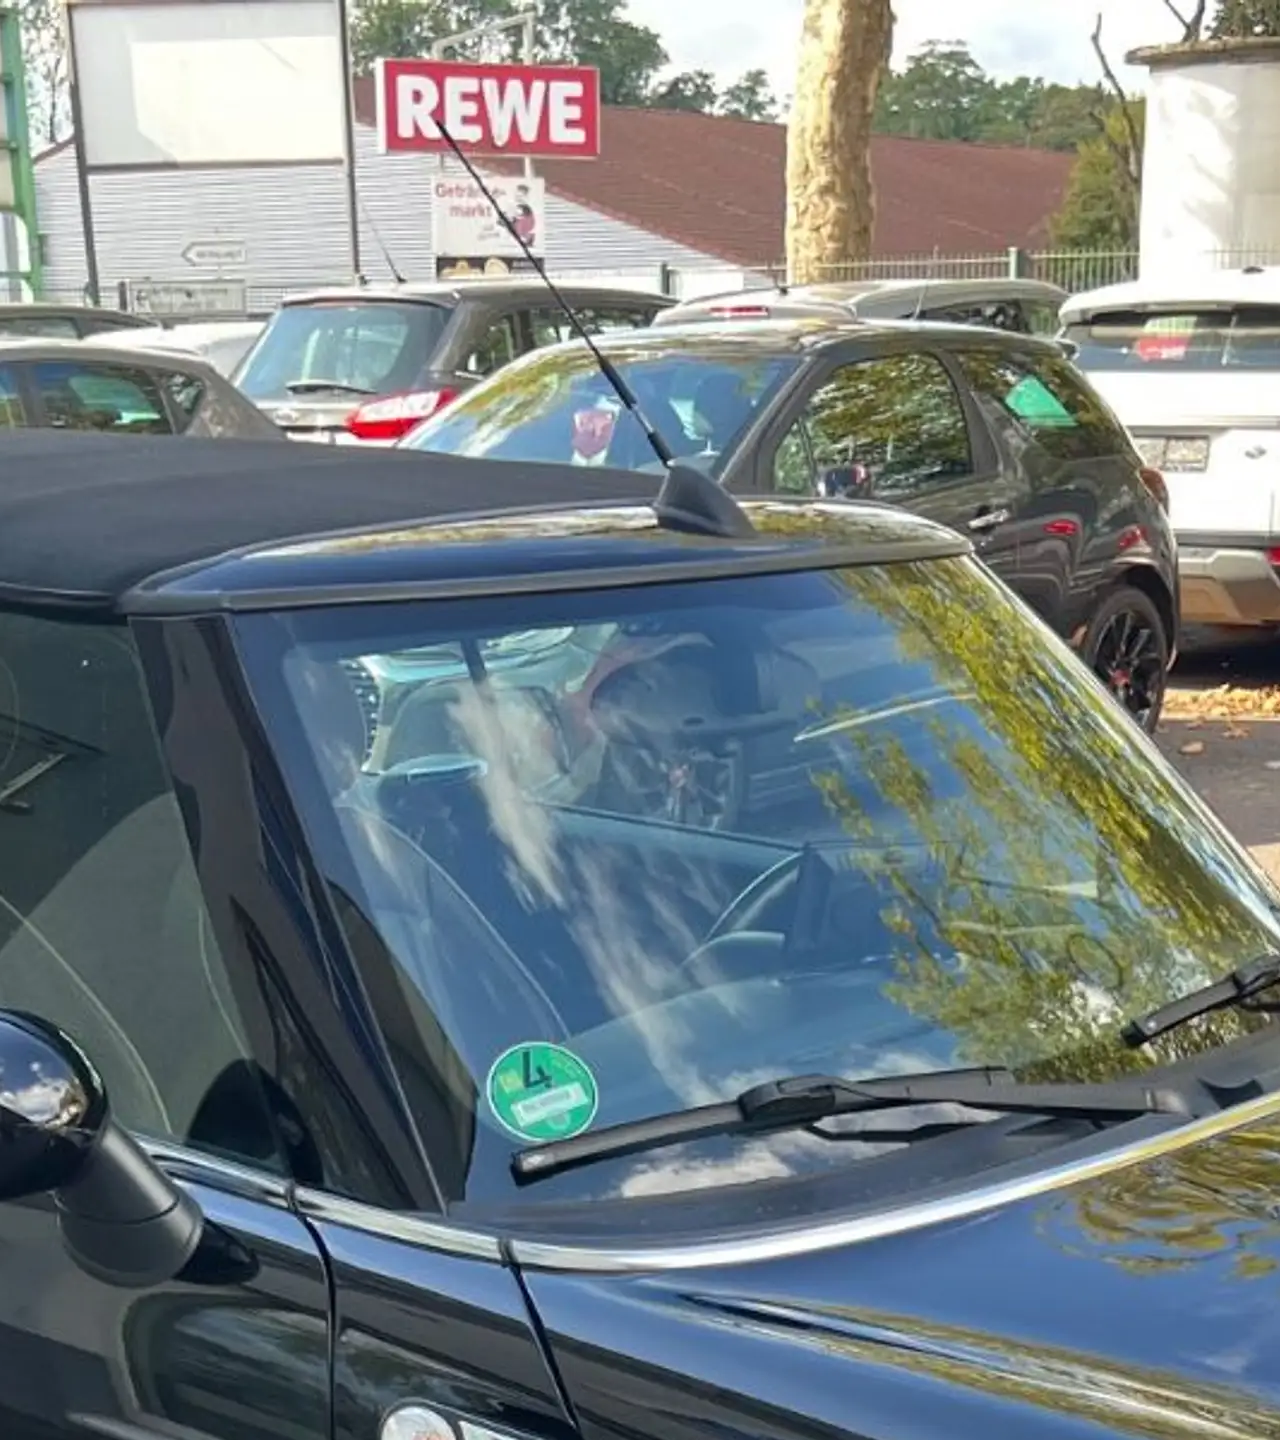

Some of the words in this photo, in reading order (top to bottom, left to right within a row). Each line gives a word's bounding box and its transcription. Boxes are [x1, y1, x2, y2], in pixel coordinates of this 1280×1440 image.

[396, 74, 586, 147] REWE
[449, 204, 492, 217] markt
[522, 1050, 553, 1088] 4
